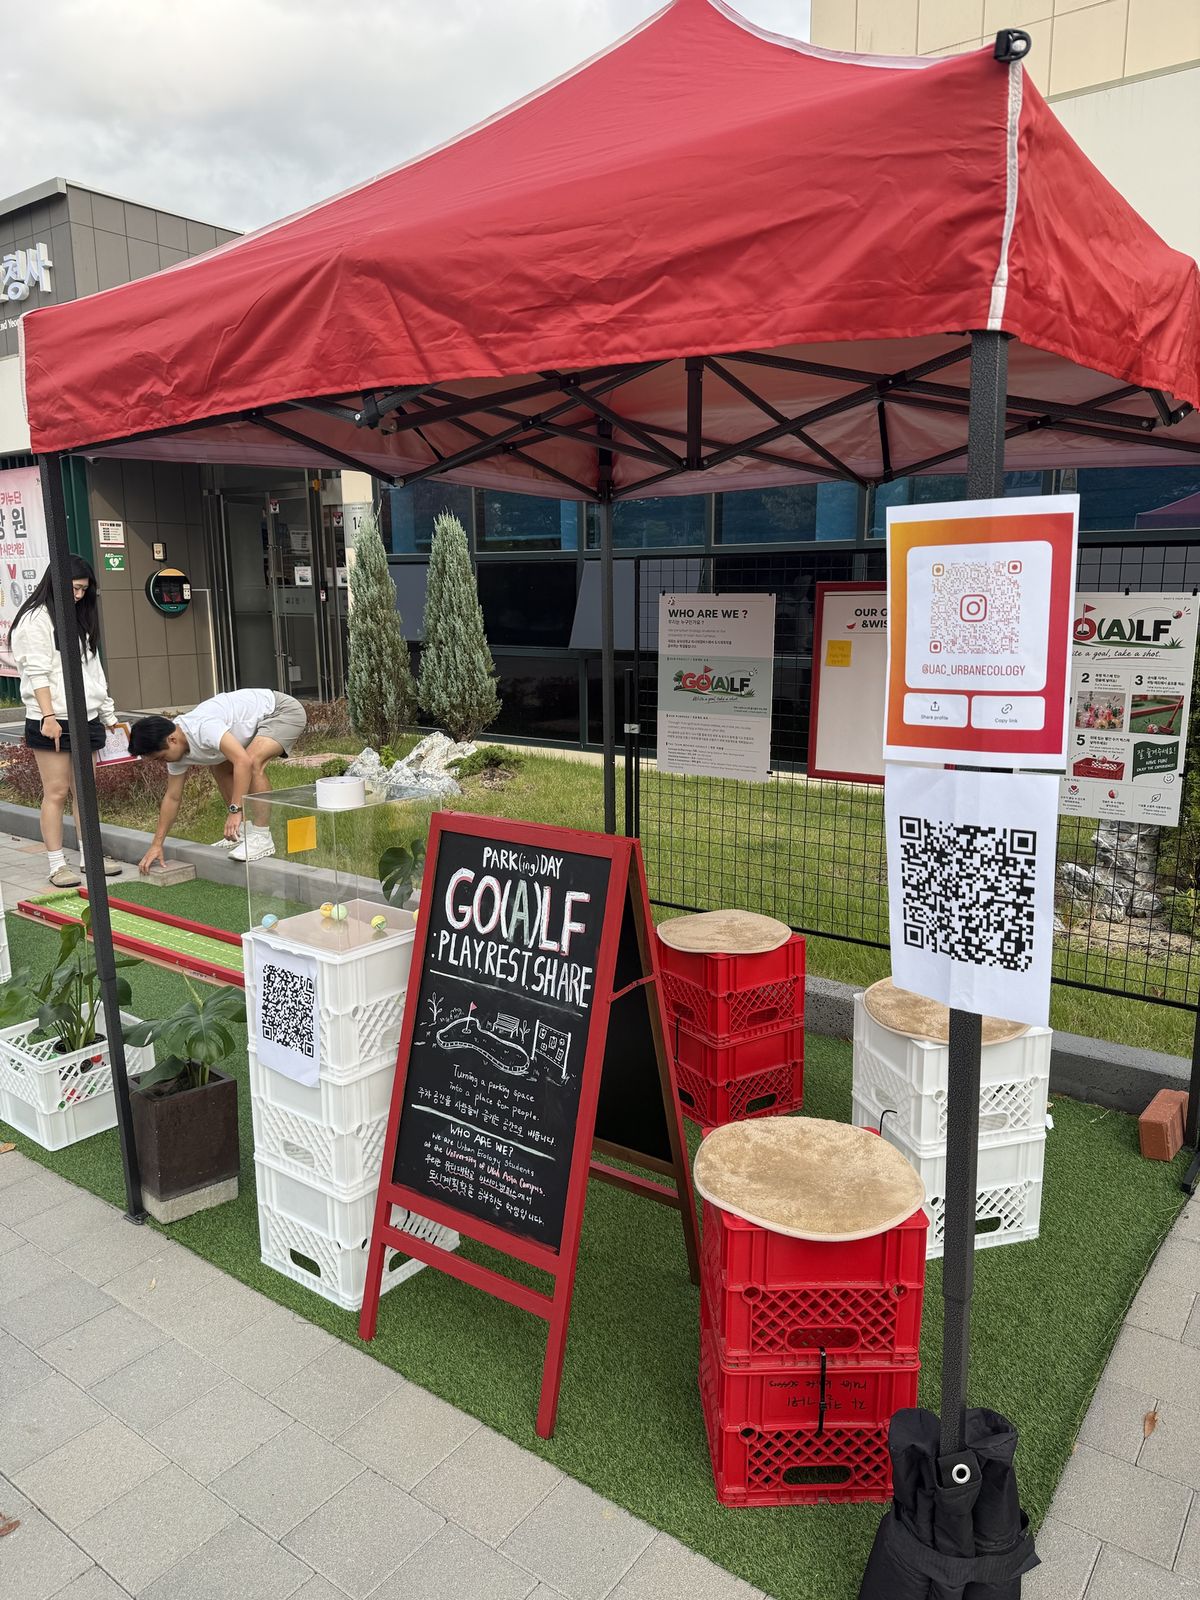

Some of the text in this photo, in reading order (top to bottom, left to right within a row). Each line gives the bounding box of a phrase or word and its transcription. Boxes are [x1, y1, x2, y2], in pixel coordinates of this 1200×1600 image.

[668, 609, 695, 618] WHO
[697, 609, 719, 618] ARE
[721, 609, 739, 619] WE
[854, 608, 878, 617] OUR
[1092, 649, 1111, 660] goal,
[1114, 649, 1132, 657] take
[1142, 649, 1161, 657] shot.
[922, 664, 1026, 677] @UAC_URBANECOLOGY
[1081, 672, 1090, 683] 2
[1135, 675, 1143, 686] 3
[681, 672, 751, 692] GO(A)LF
[1076, 734, 1085, 746] 5
[445, 867, 591, 957] GO(A)LF
[453, 1063, 478, 1088] Turning
[488, 1081, 510, 1099] parking
[513, 1089, 535, 1102] space
[450, 1081, 463, 1093] into
[474, 1093, 493, 1106] place
[496, 1099, 510, 1110] for
[512, 1105, 540, 1121] people.
[418, 1086, 432, 1099] 주차
[433, 1090, 452, 1107] 공간을
[455, 1100, 479, 1118] 사람들이
[502, 1118, 524, 1138] 공간으로
[450, 1123, 514, 1157] WHO ARE WE?
[443, 1137, 454, 1146] are
[456, 1140, 475, 1154] Urban
[477, 1148, 501, 1169] Ecology
[445, 1147, 477, 1168] University
[479, 1161, 486, 1170] of
[487, 1165, 500, 1178] Utah
[502, 1171, 518, 1185] Asia
[478, 1188, 503, 1210] 공부하는
